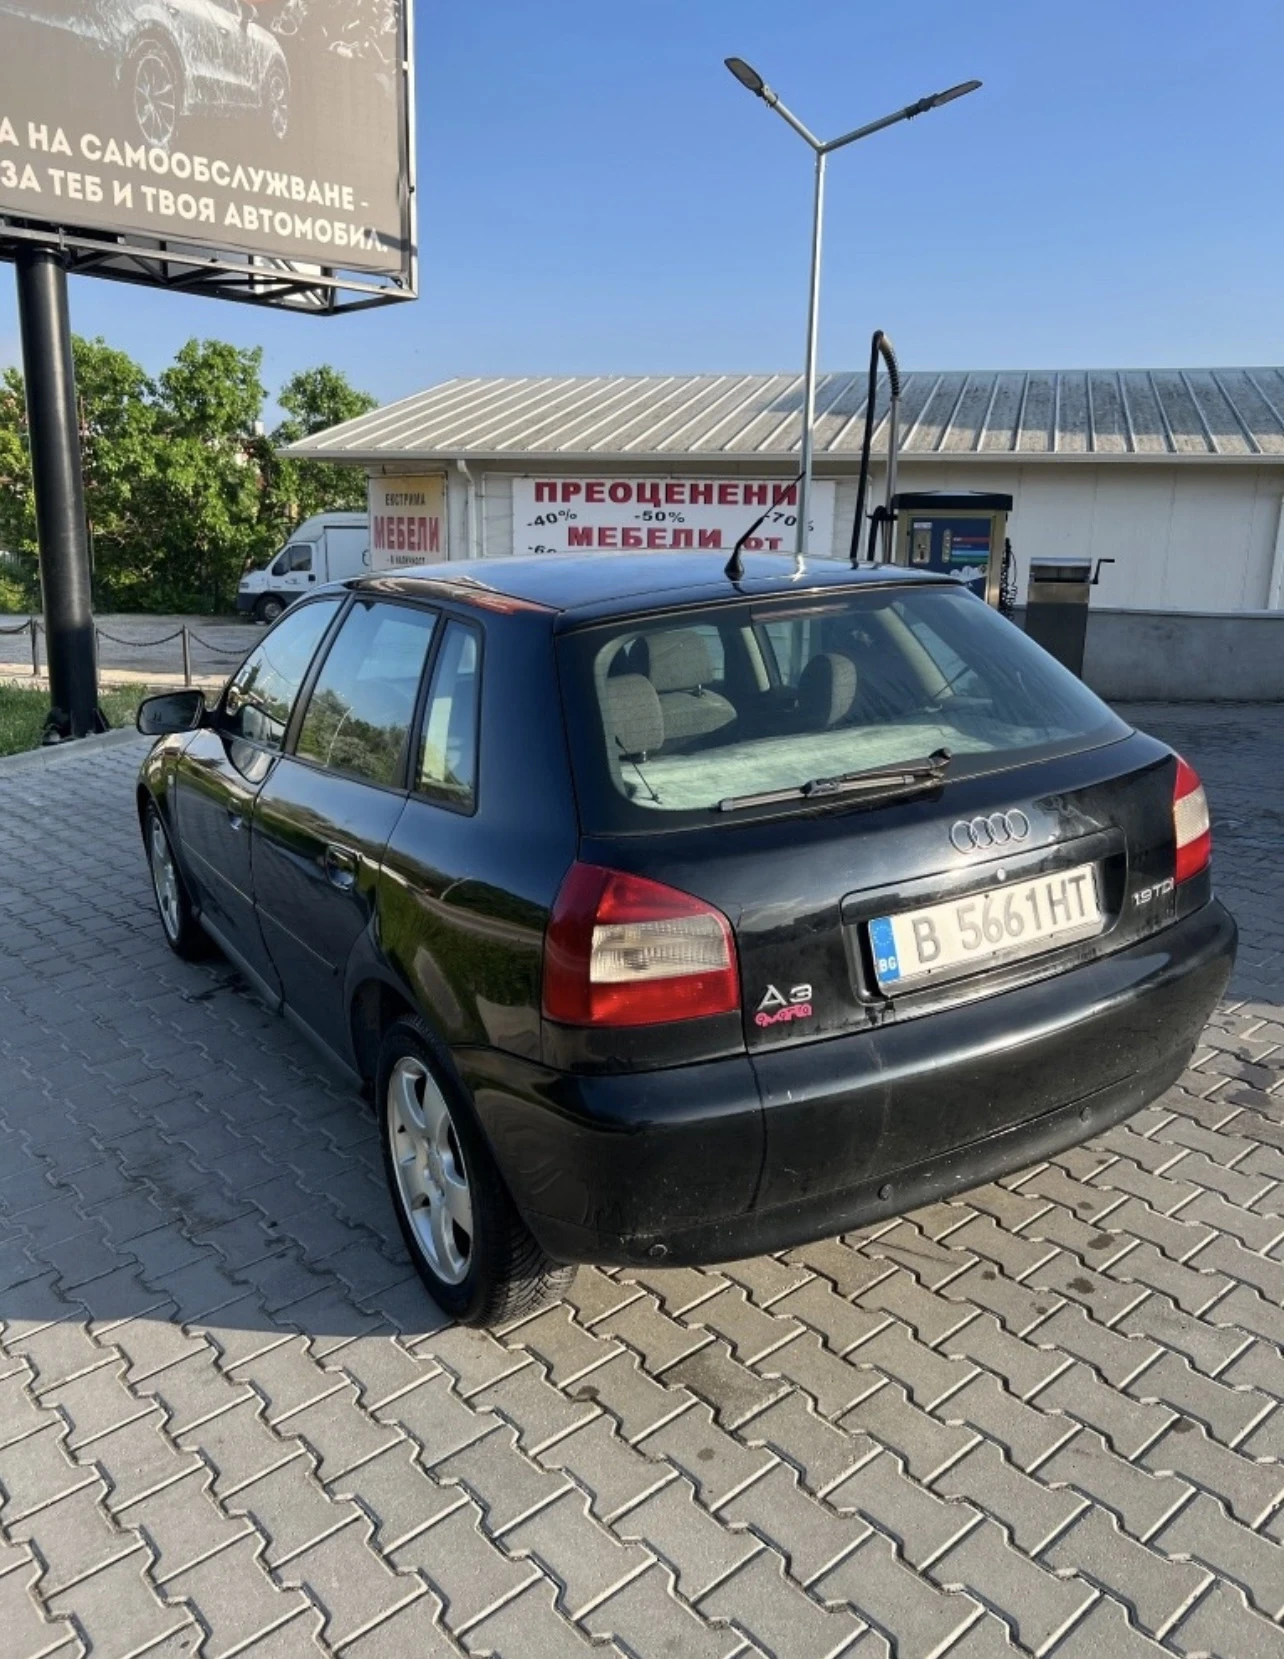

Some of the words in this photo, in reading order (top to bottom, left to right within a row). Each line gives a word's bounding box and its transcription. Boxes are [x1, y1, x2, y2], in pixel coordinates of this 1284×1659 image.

[28, 121, 73, 156] НА
[80, 133, 354, 211] САМООБСЛУЖВАНЕ
[0, 159, 42, 193] ЗА
[48, 168, 103, 202] ТЕБ
[112, 180, 133, 208] И
[141, 185, 216, 223] ТВОЯ
[534, 481, 798, 508] ПРЕОЦЕНЕНИ
[526, 508, 578, 527] -40%
[634, 510, 685, 523] -50%
[374, 516, 440, 552] МЕБЕЛИ
[567, 526, 722, 549] МЕБЕЛИ
[911, 916, 941, 964] B
[879, 955, 898, 973] BG
[757, 984, 812, 1011] A3
